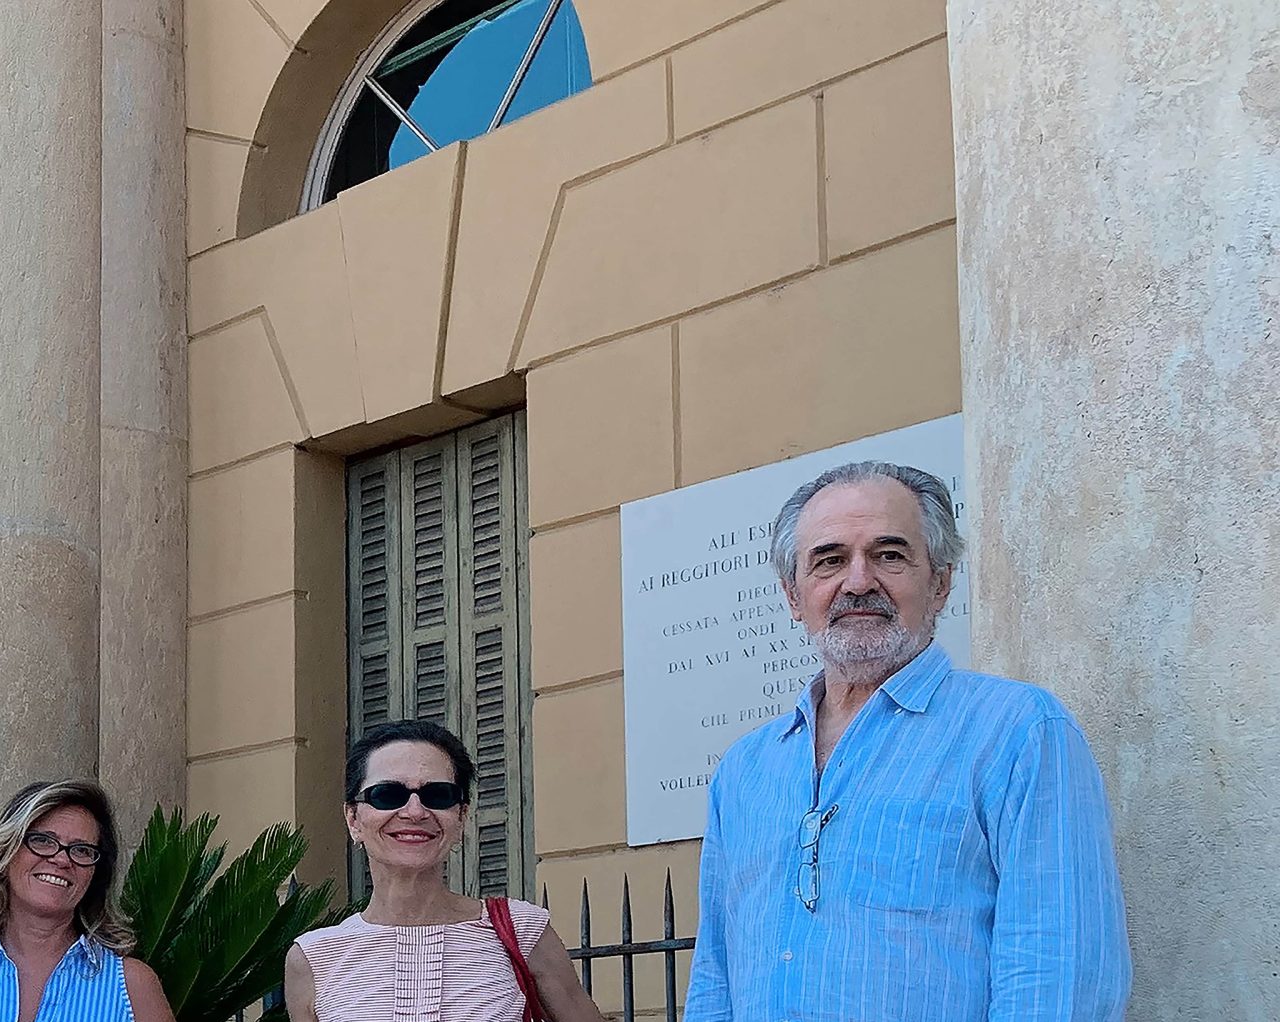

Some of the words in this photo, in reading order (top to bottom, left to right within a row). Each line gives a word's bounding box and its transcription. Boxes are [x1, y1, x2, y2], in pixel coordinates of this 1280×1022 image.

[638, 576, 653, 594] AI
[661, 556, 749, 588] REGGITORI
[756, 549, 768, 565] D
[737, 583, 780, 602] DIECI
[662, 616, 719, 638] CESSATA
[729, 602, 785, 623] APPENA
[705, 651, 730, 666] XVI
[769, 639, 788, 653] XX
[763, 653, 818, 674] PERCOS
[763, 675, 814, 699] QUES
[659, 774, 712, 791] VOLLER
